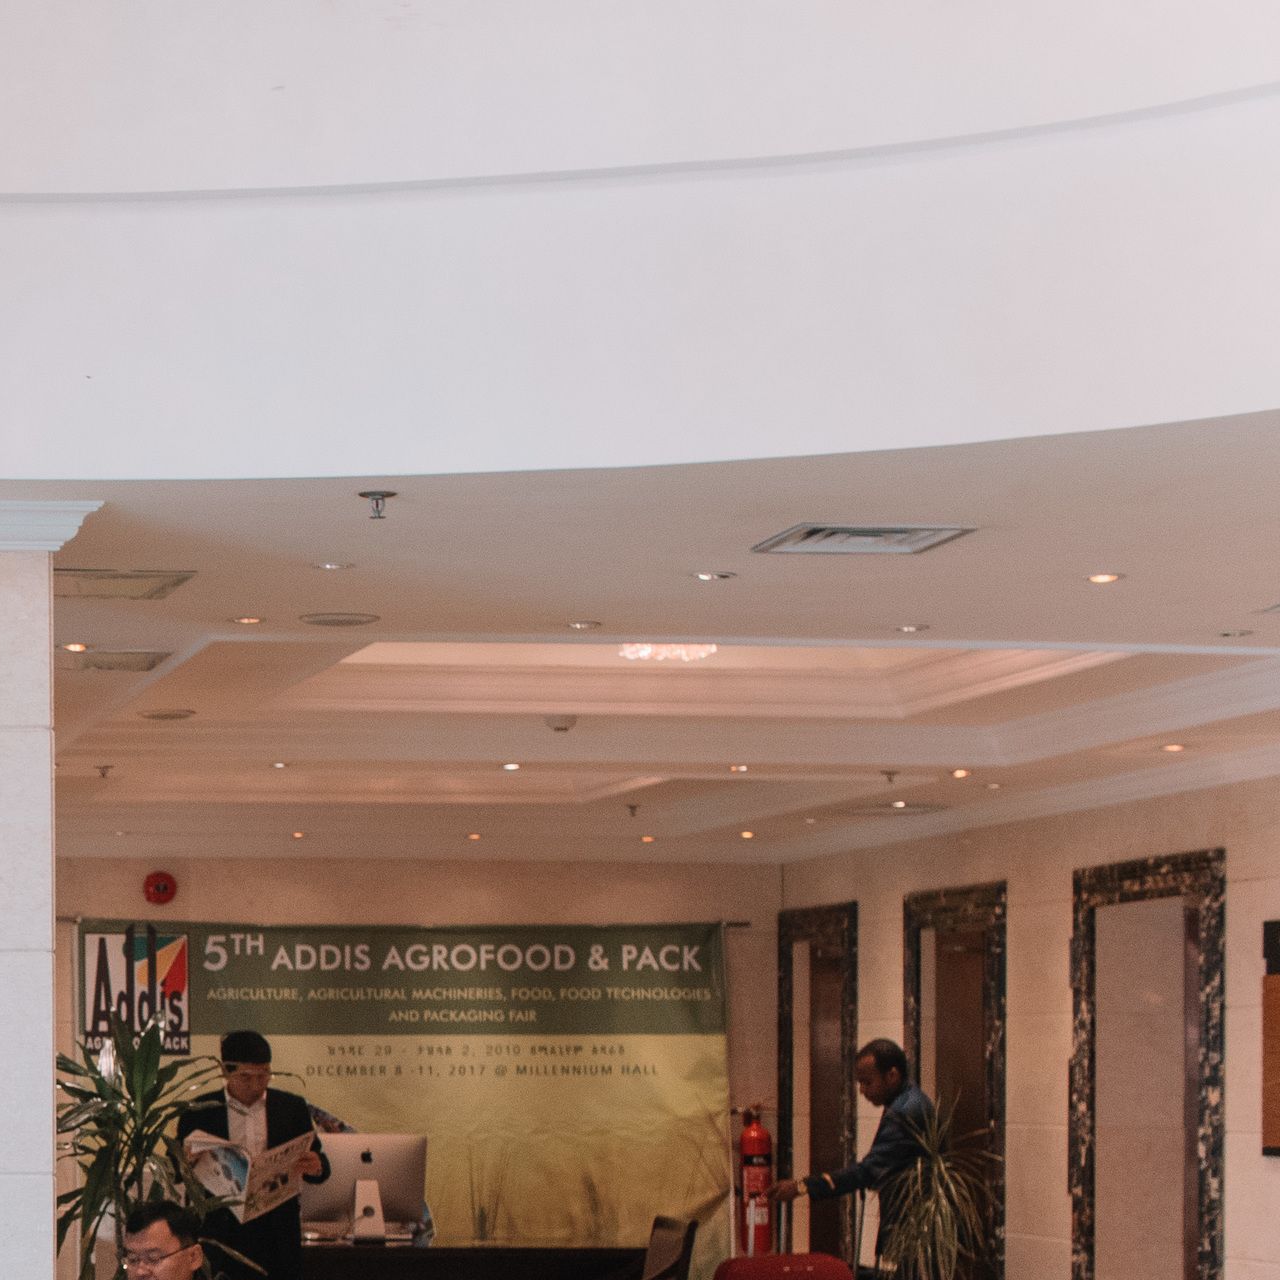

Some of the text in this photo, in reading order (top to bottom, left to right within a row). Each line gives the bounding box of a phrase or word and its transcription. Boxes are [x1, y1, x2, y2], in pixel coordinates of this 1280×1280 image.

[203, 933, 703, 972] 5TH ADDIS AGROFOOD & PACK
[92, 924, 184, 1032] Addis
[206, 987, 712, 1002] AGRICULTURE, AGRICULTURAL MACHINERIES, FOOD, FOOD TECHNOLOGIES
[390, 1009, 537, 1023] AND PACKAGING FAIR
[306, 1064, 387, 1077] DECEMBER
[516, 1064, 613, 1076] MILLENNIUM
[621, 1064, 657, 1076] HALL
